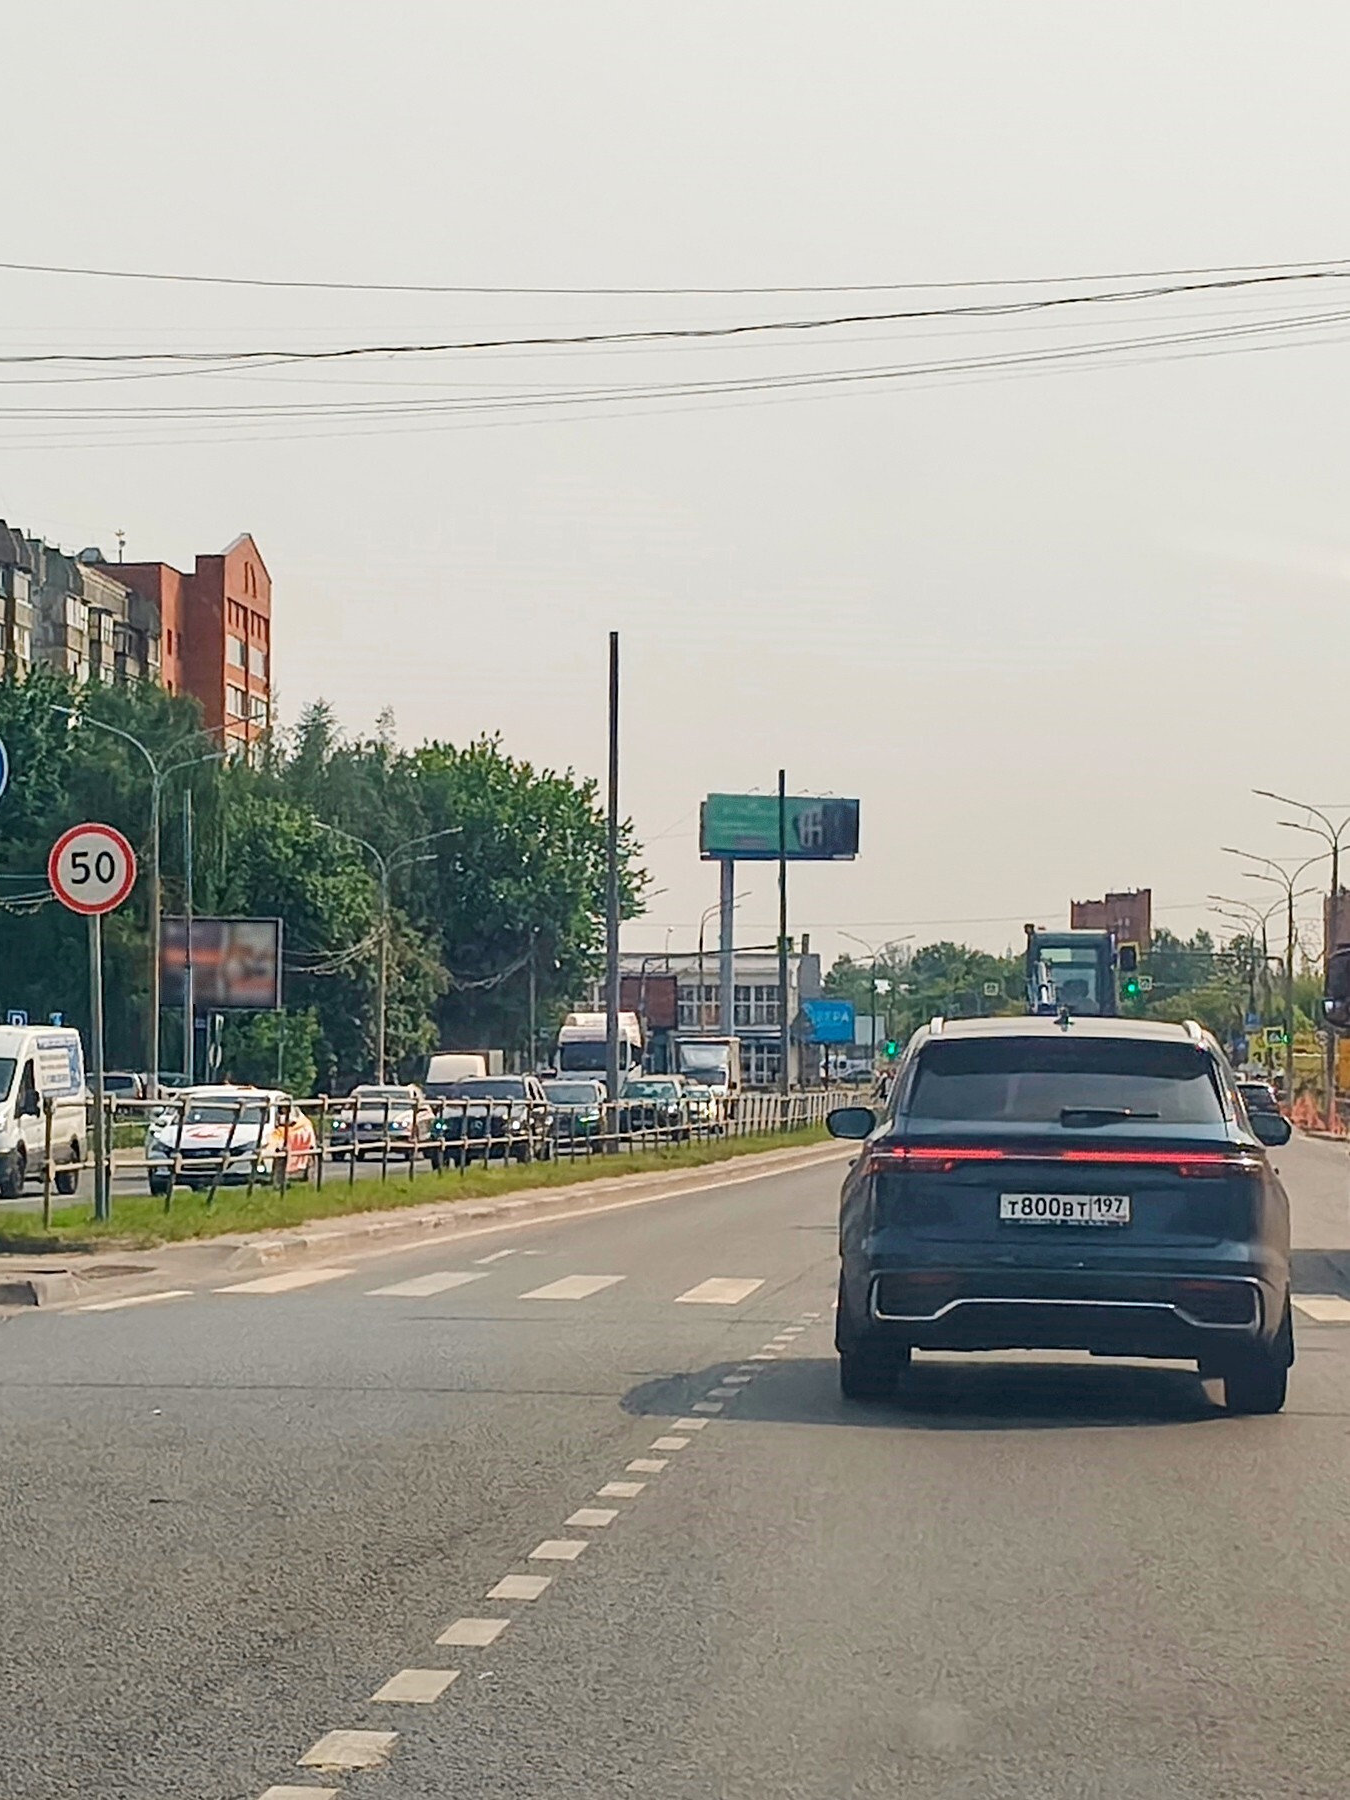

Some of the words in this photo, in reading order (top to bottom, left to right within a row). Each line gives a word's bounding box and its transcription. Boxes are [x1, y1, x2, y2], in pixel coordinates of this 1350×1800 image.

[71, 851, 115, 884] 50
[1008, 1197, 1088, 1218] Т800ВТ
[1093, 1198, 1123, 1213] 197
